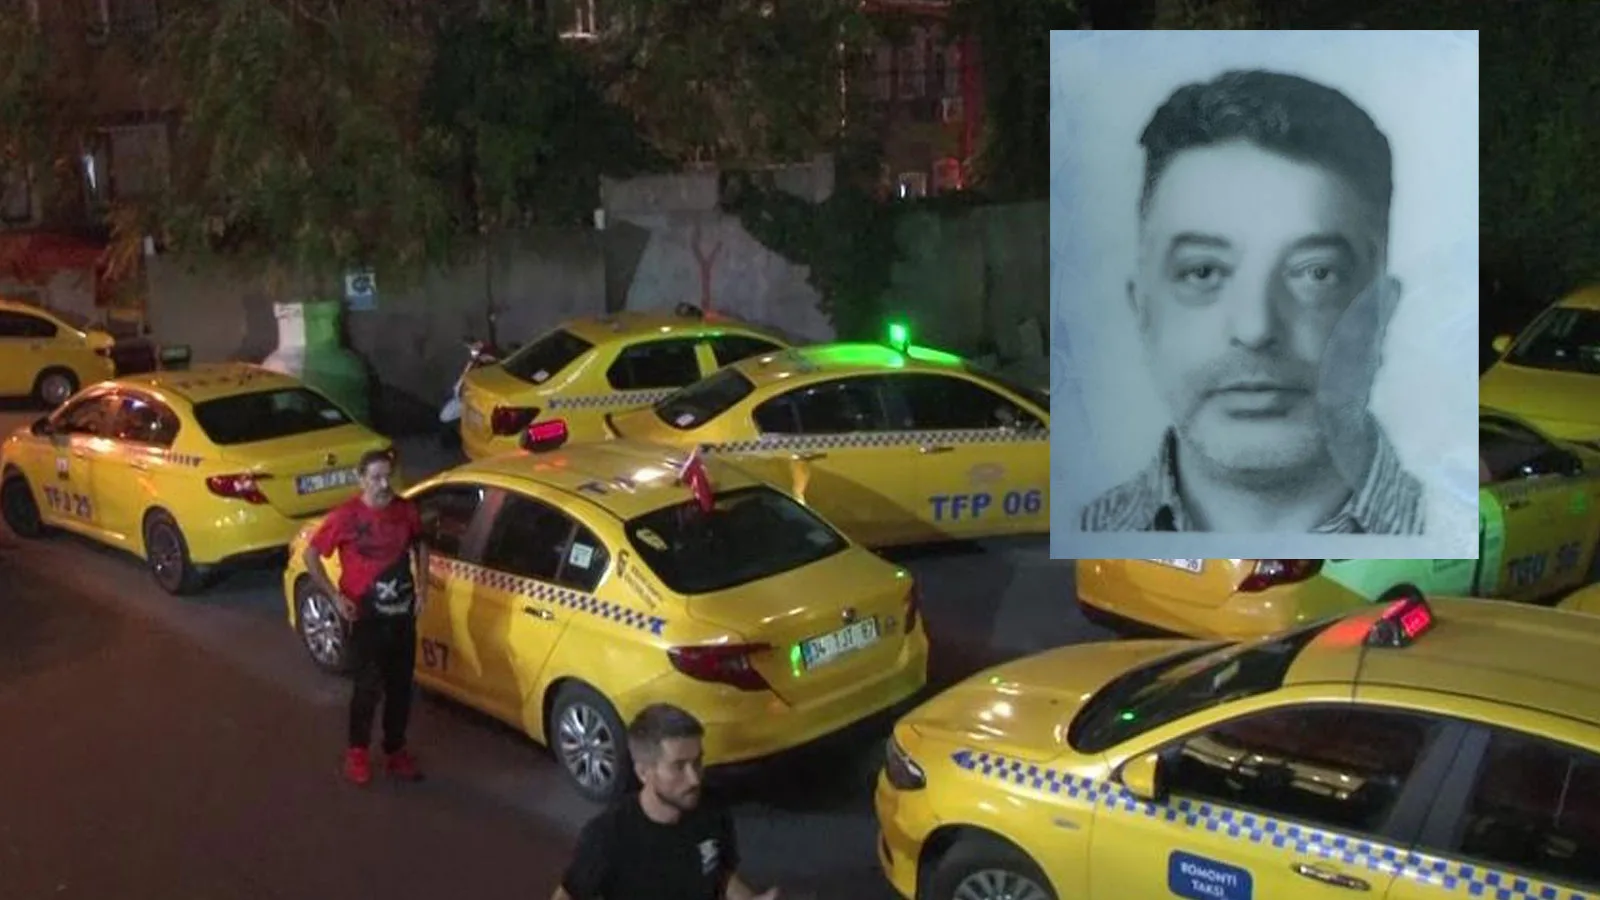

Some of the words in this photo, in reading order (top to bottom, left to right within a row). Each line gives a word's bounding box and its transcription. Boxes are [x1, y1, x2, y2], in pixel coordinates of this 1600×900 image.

[929, 494, 992, 521] TFP
[1003, 490, 1041, 515] 06
[421, 638, 448, 670] 87
